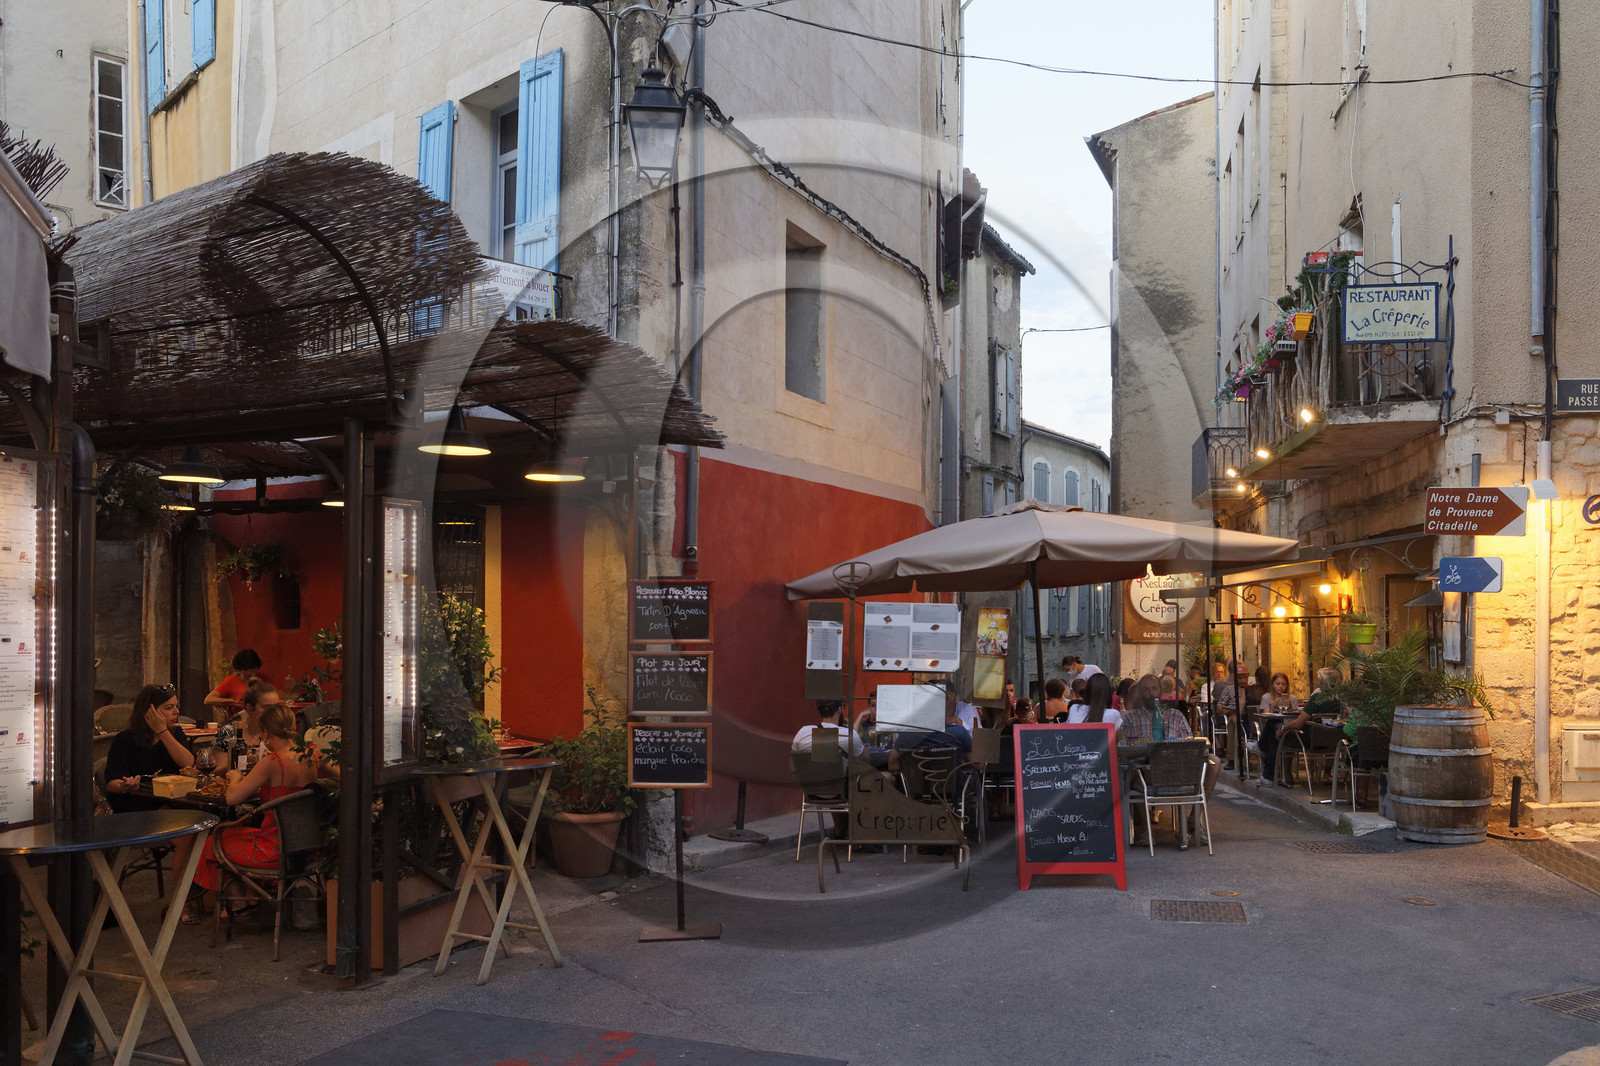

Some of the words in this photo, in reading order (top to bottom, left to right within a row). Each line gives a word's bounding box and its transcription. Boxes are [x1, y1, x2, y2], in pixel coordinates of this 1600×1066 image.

[532, 278, 550, 292] louer
[1349, 289, 1433, 304] RESTAURANT
[1350, 318, 1371, 331] La
[1372, 308, 1430, 330] Crêperie
[1581, 384, 1599, 394] RUE
[1430, 493, 1461, 503] Notre
[1466, 493, 1499, 503] Dame
[1429, 507, 1441, 517] de
[1446, 507, 1494, 517] Provence
[1427, 520, 1478, 531] Citadelle
[637, 605, 661, 616] Tatin
[1140, 596, 1185, 617] Crêpere
[634, 757, 667, 770] mangue
